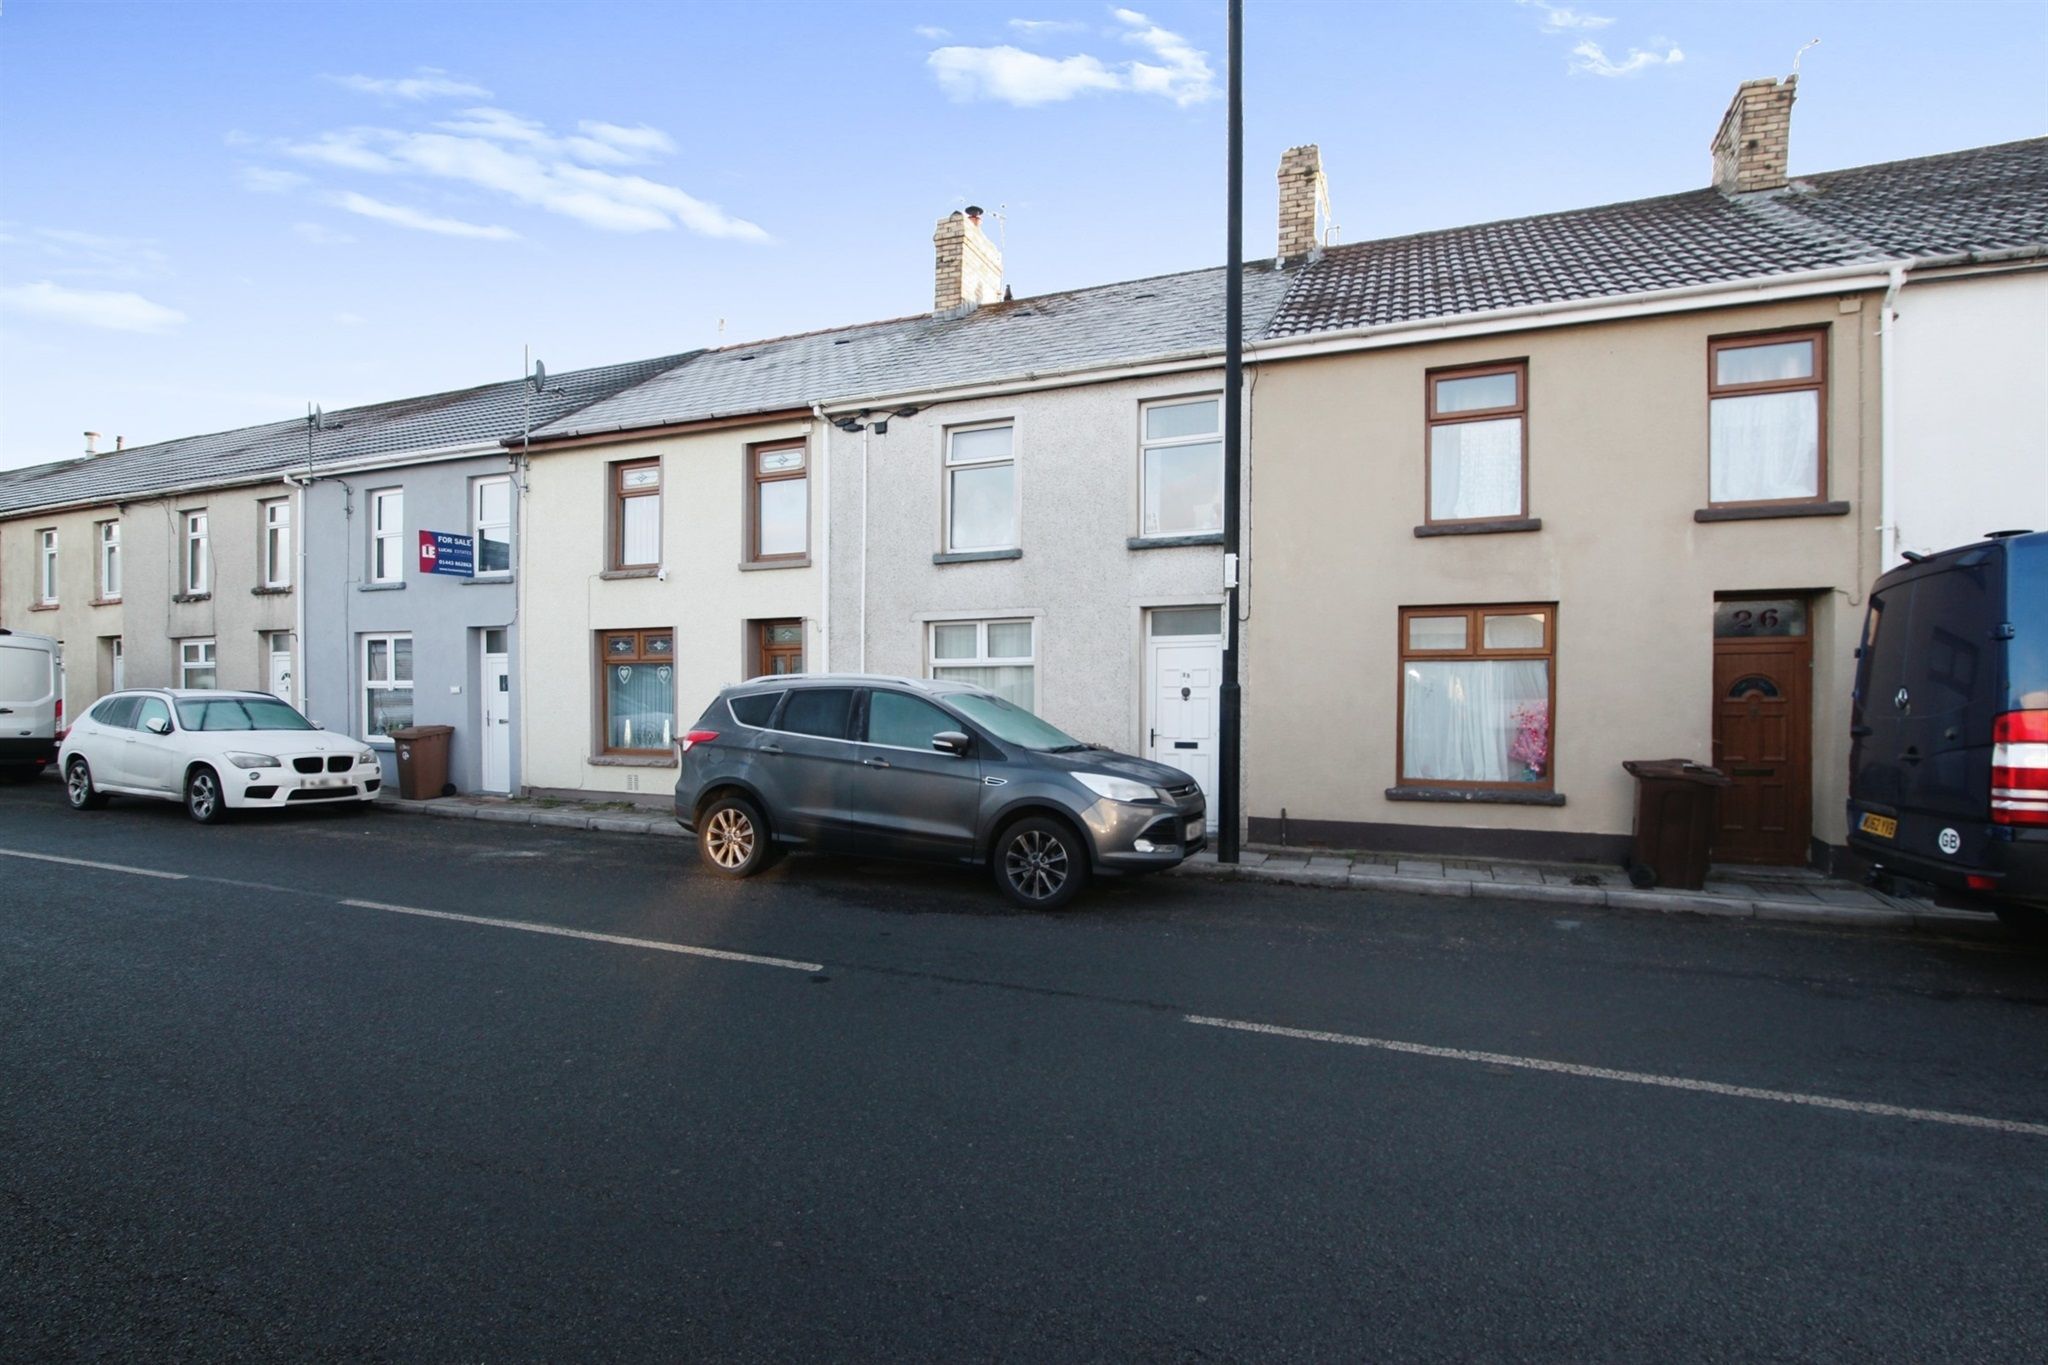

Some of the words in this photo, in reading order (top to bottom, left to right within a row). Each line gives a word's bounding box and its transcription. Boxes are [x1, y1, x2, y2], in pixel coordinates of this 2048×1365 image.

[437, 535, 453, 544] FOR
[454, 538, 472, 547] SALE
[1732, 608, 1778, 629] 26
[1941, 832, 1958, 849] GB
